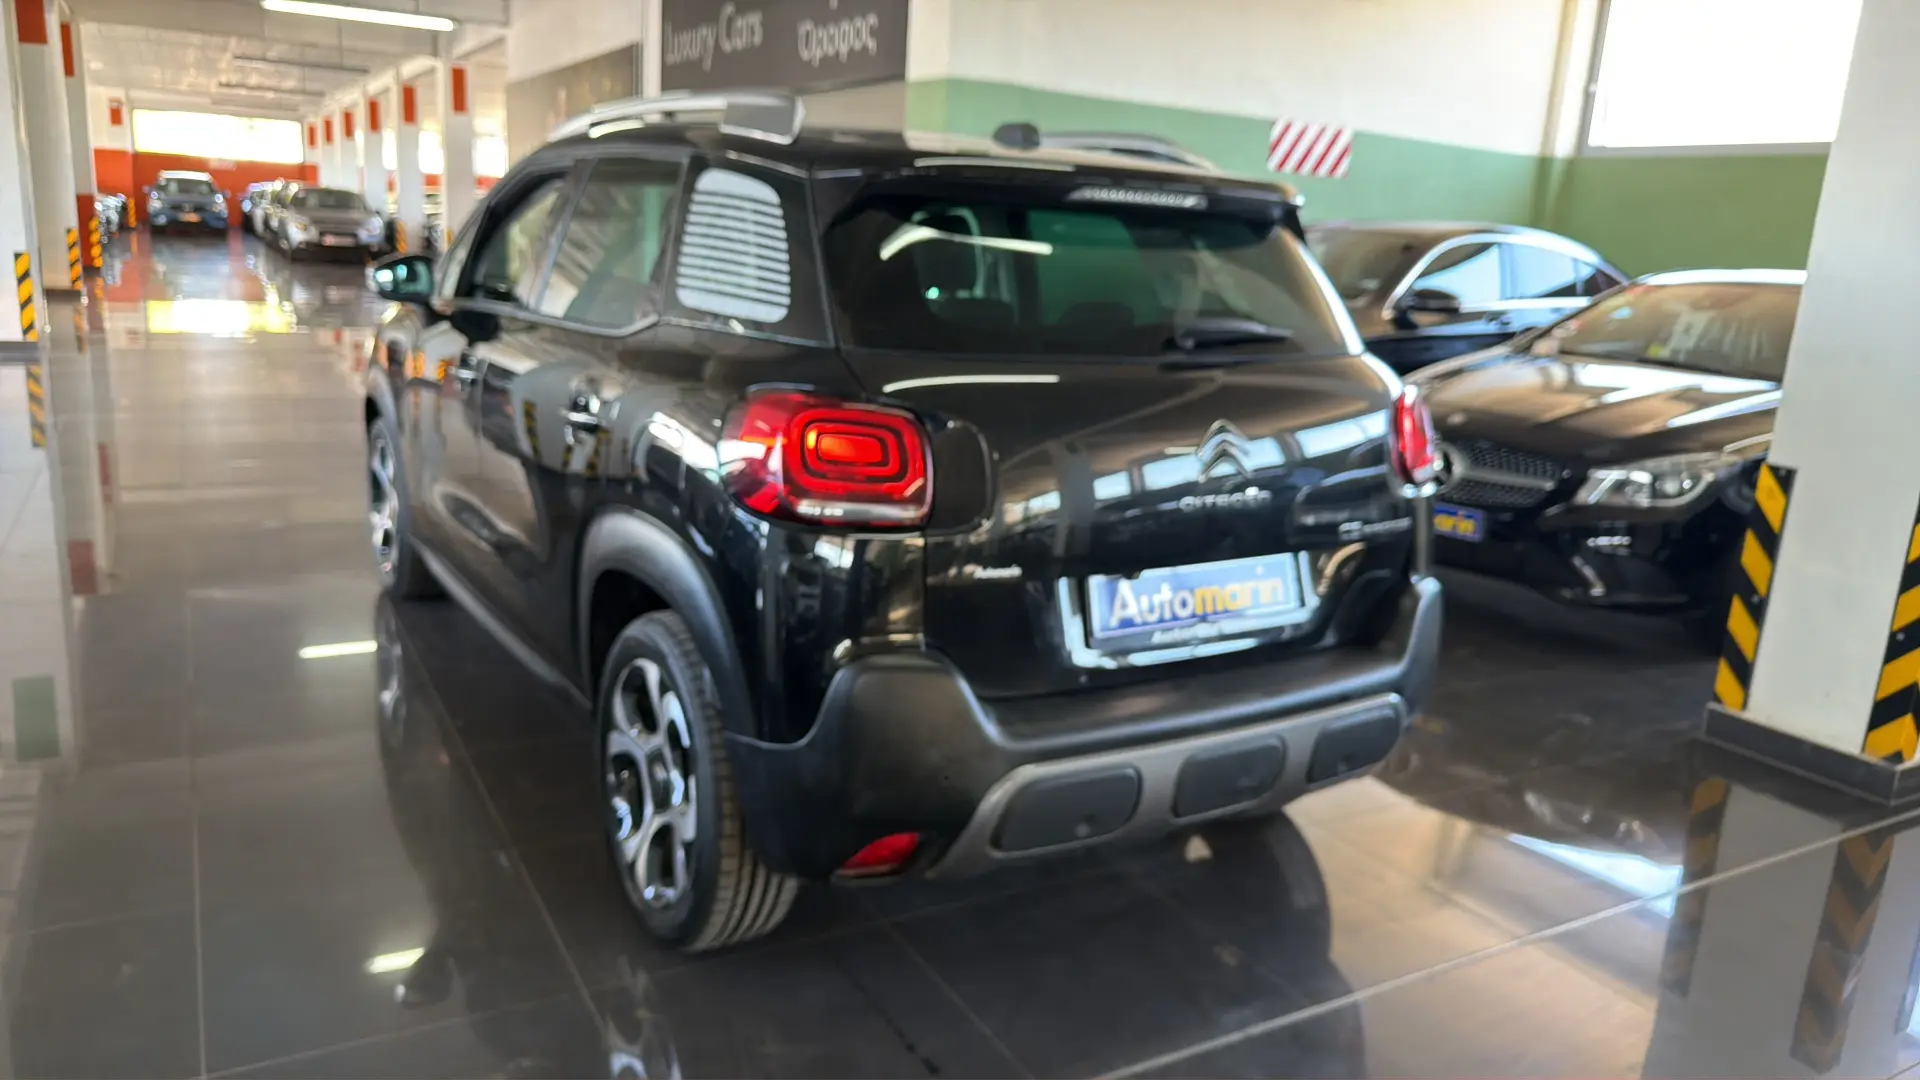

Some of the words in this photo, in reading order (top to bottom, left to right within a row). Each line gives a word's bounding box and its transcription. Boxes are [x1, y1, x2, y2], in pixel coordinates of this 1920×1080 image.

[664, 21, 717, 71] Luxury
[719, 1, 763, 54] Cars
[1110, 564, 1284, 627] Automarin
